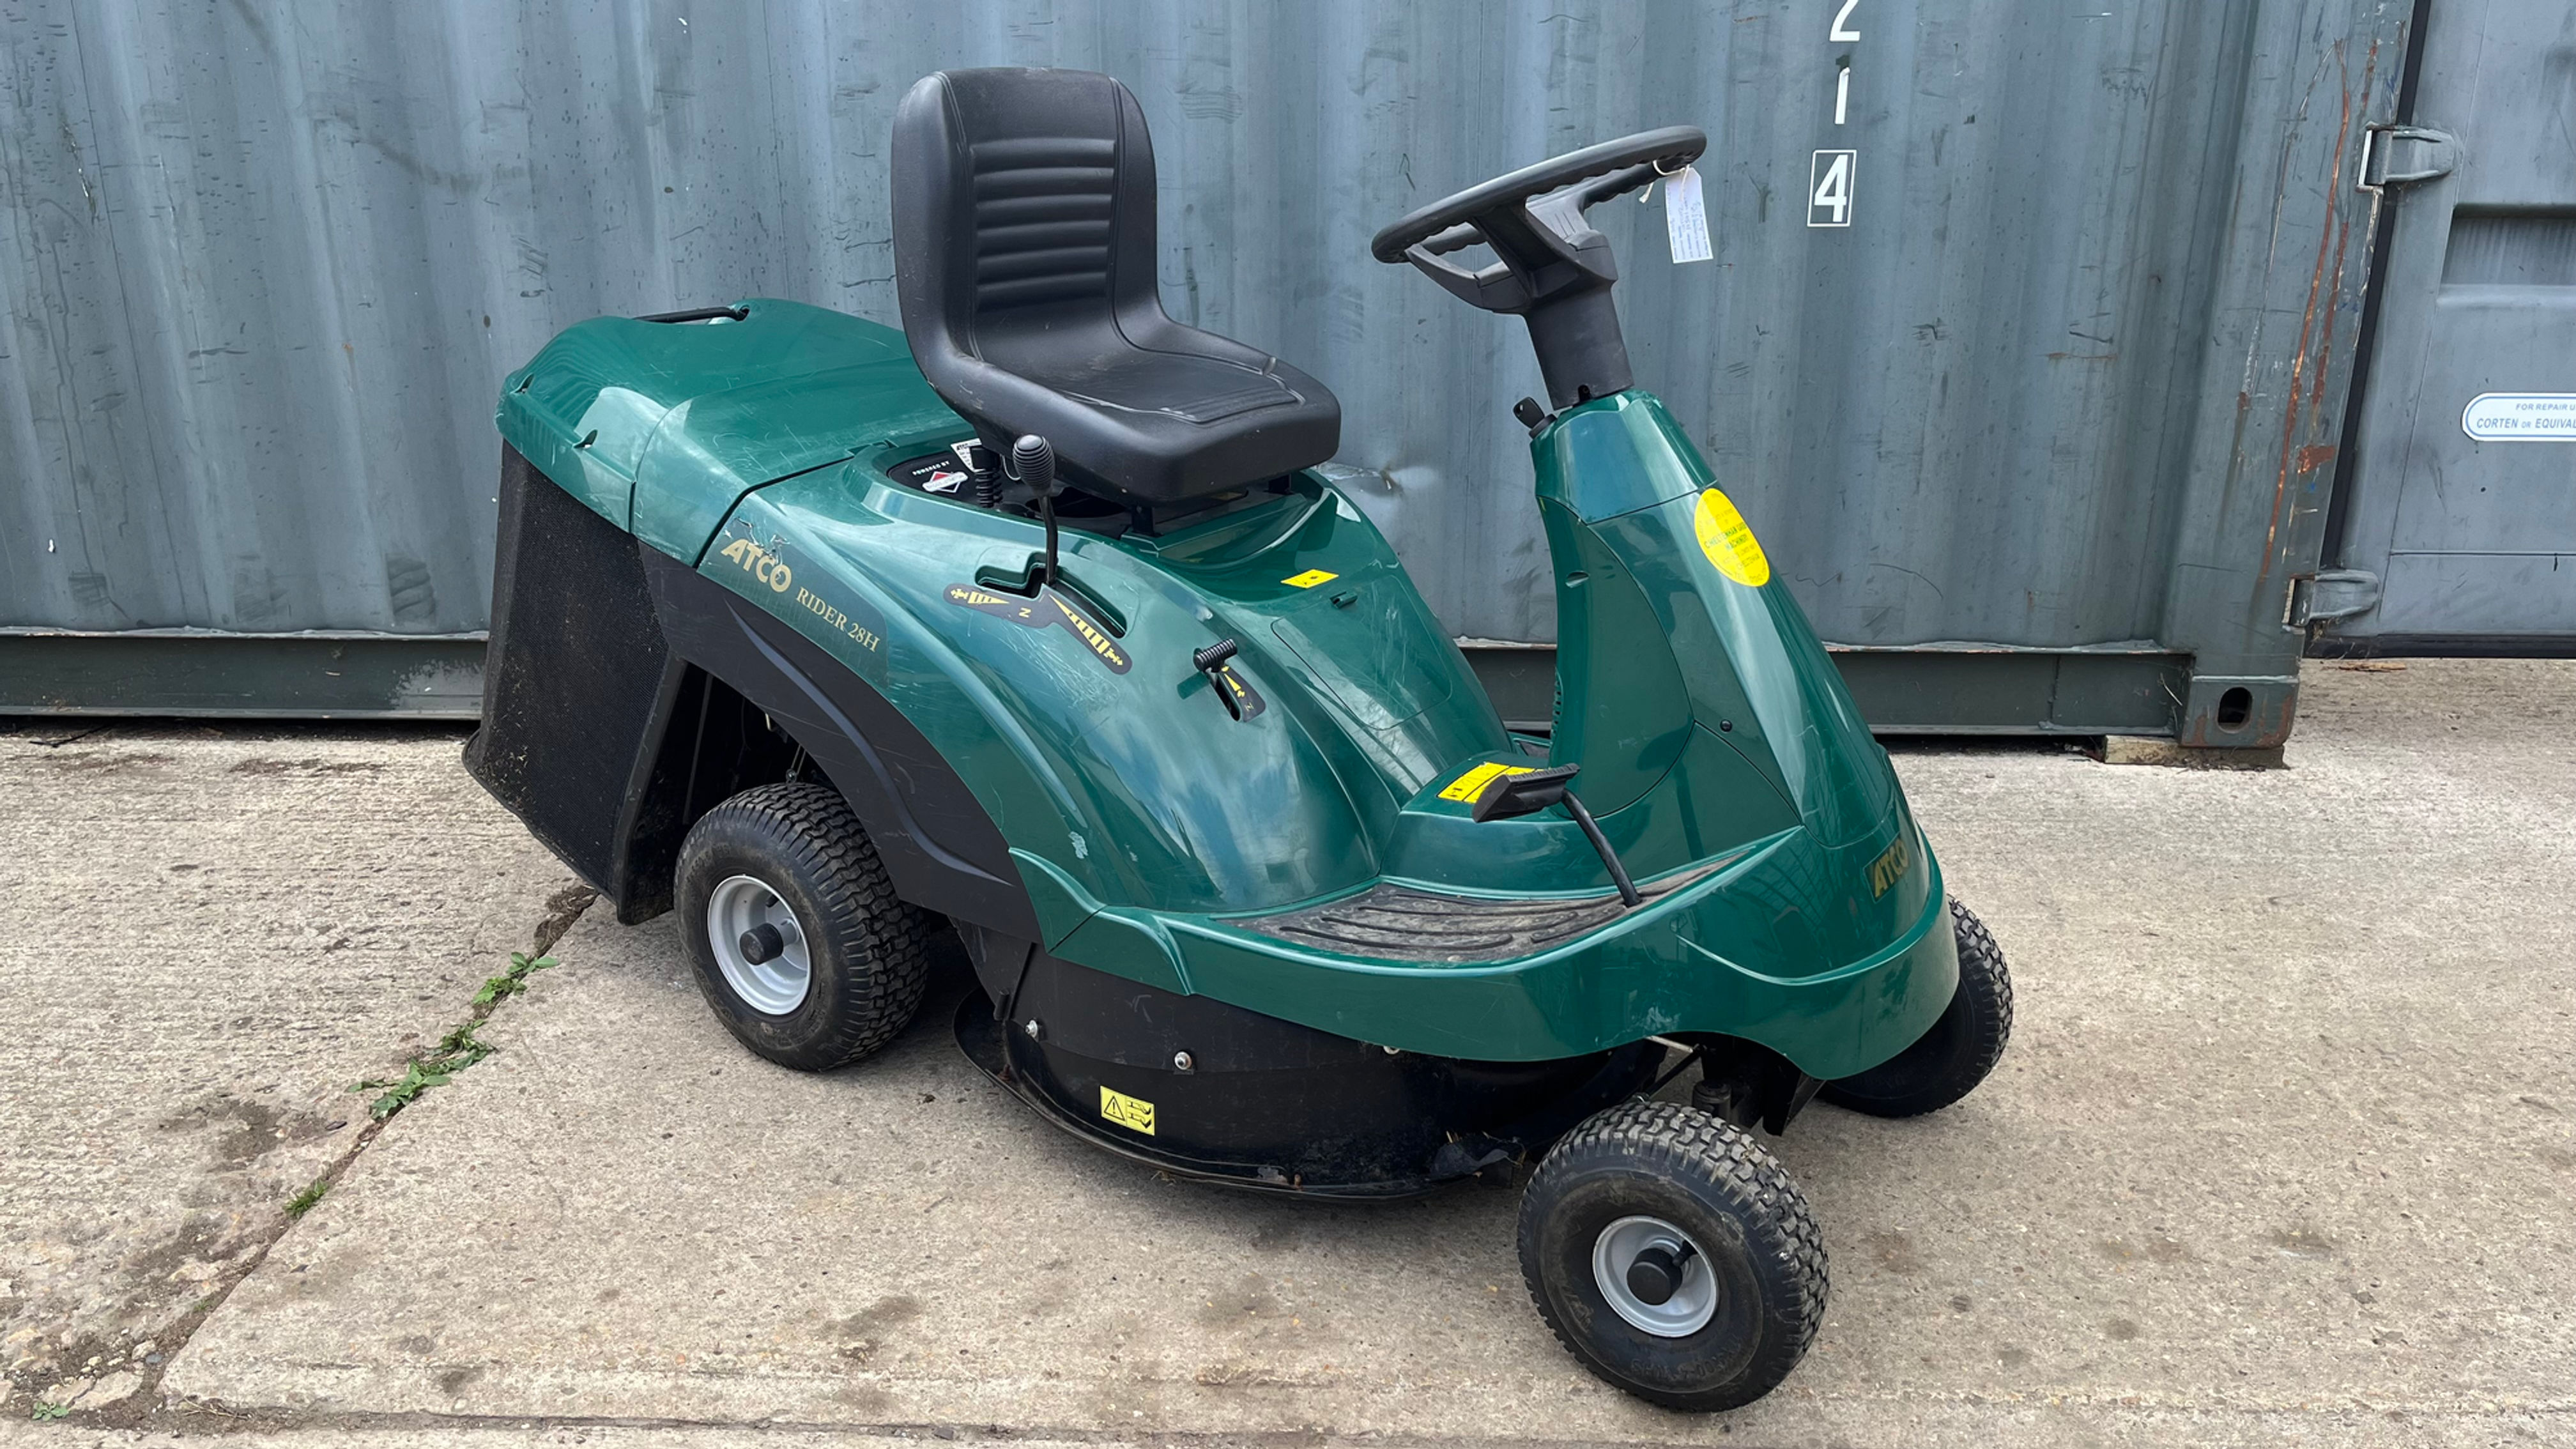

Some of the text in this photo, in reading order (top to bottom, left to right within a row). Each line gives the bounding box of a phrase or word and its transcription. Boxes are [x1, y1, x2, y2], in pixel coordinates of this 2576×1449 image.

[1814, 154, 1848, 222] 4
[2476, 417, 2519, 429] CORTEN
[2520, 420, 2531, 429] OR
[721, 538, 881, 653] ATCO RIDER 28H
[1874, 838, 1909, 898] ATCO
